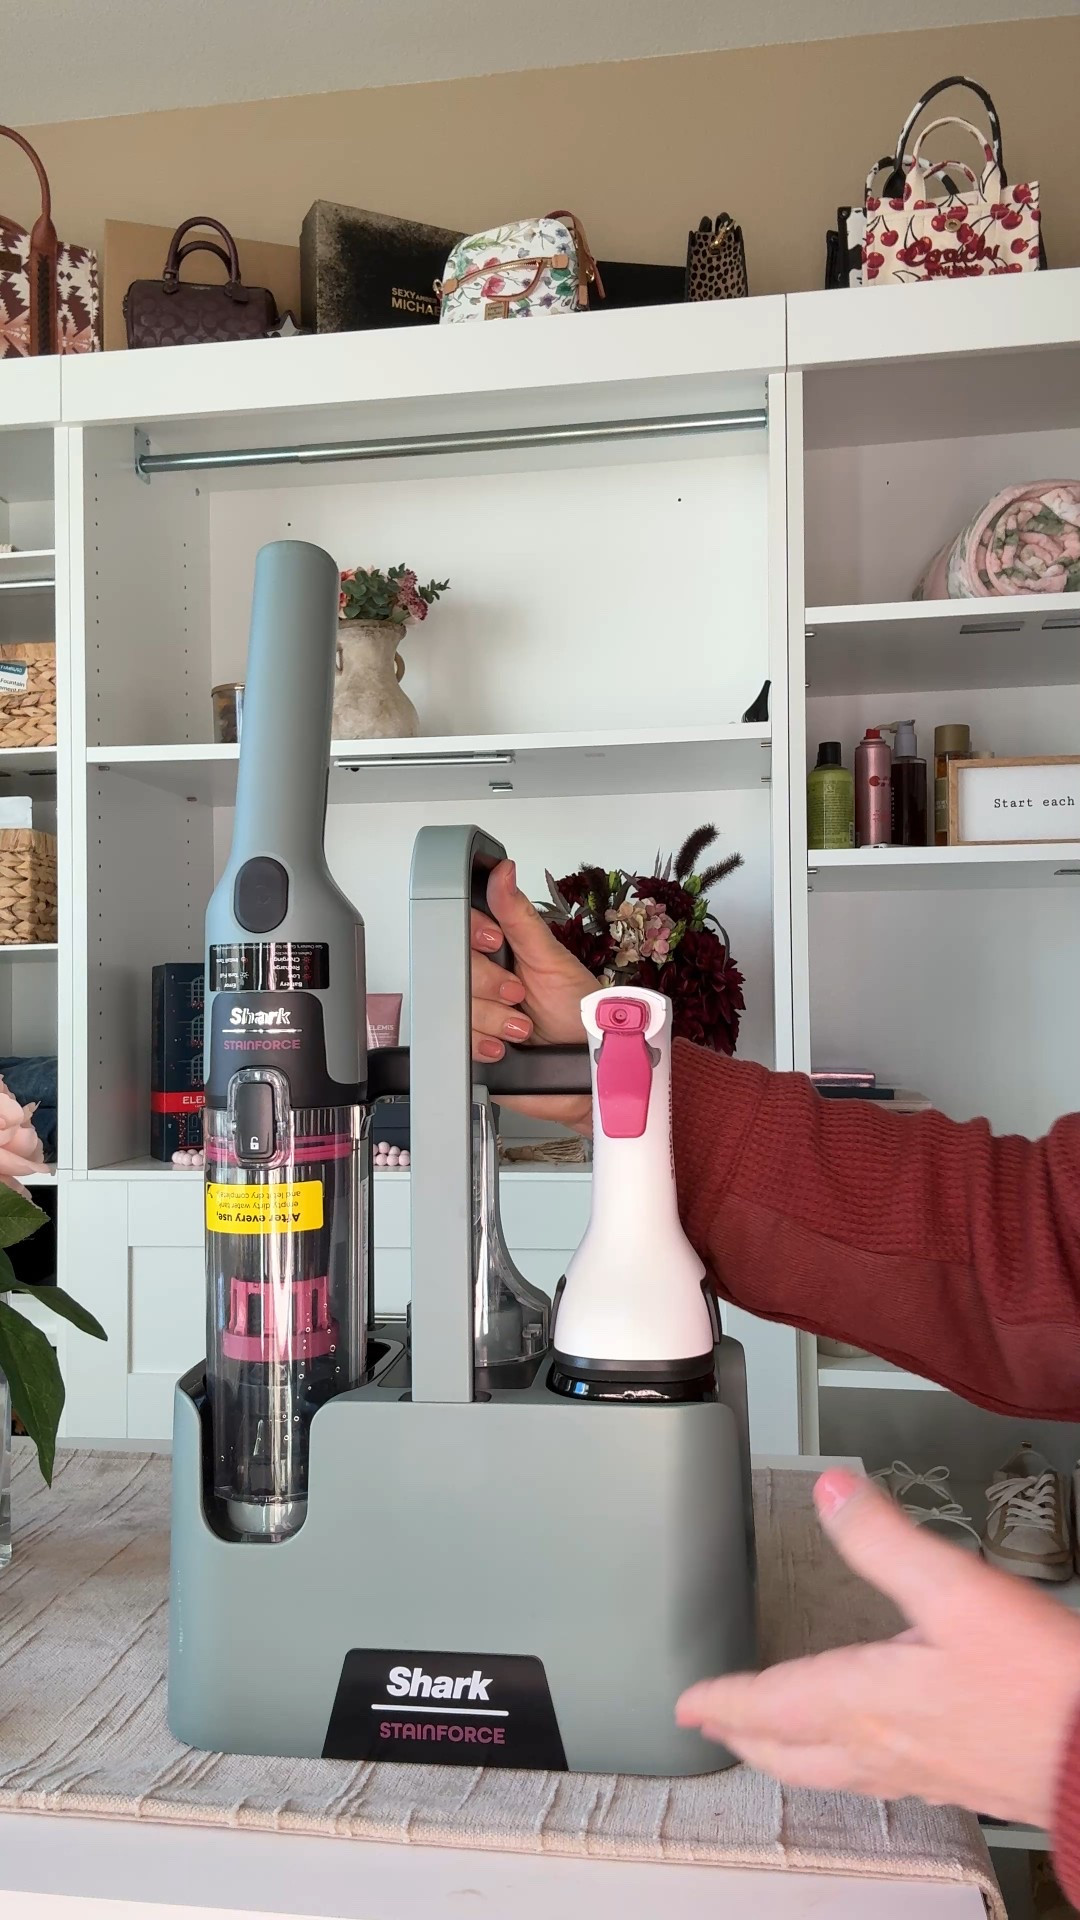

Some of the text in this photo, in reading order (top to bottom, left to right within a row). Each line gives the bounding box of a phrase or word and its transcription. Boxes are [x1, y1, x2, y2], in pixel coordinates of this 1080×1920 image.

[391, 287, 416, 299] SEXY
[391, 297, 441, 317] MICHAE
[1, 677, 25, 688] Fountain
[994, 796, 1075, 808] Start each
[229, 1007, 291, 1026] Shark
[223, 1039, 301, 1051] STAINFORCE
[182, 1095, 206, 1104] ELE
[216, 1211, 233, 1221] use,
[235, 1212, 266, 1223] every
[386, 1666, 494, 1701] Shark
[379, 1721, 506, 1745] STAINFORCE
